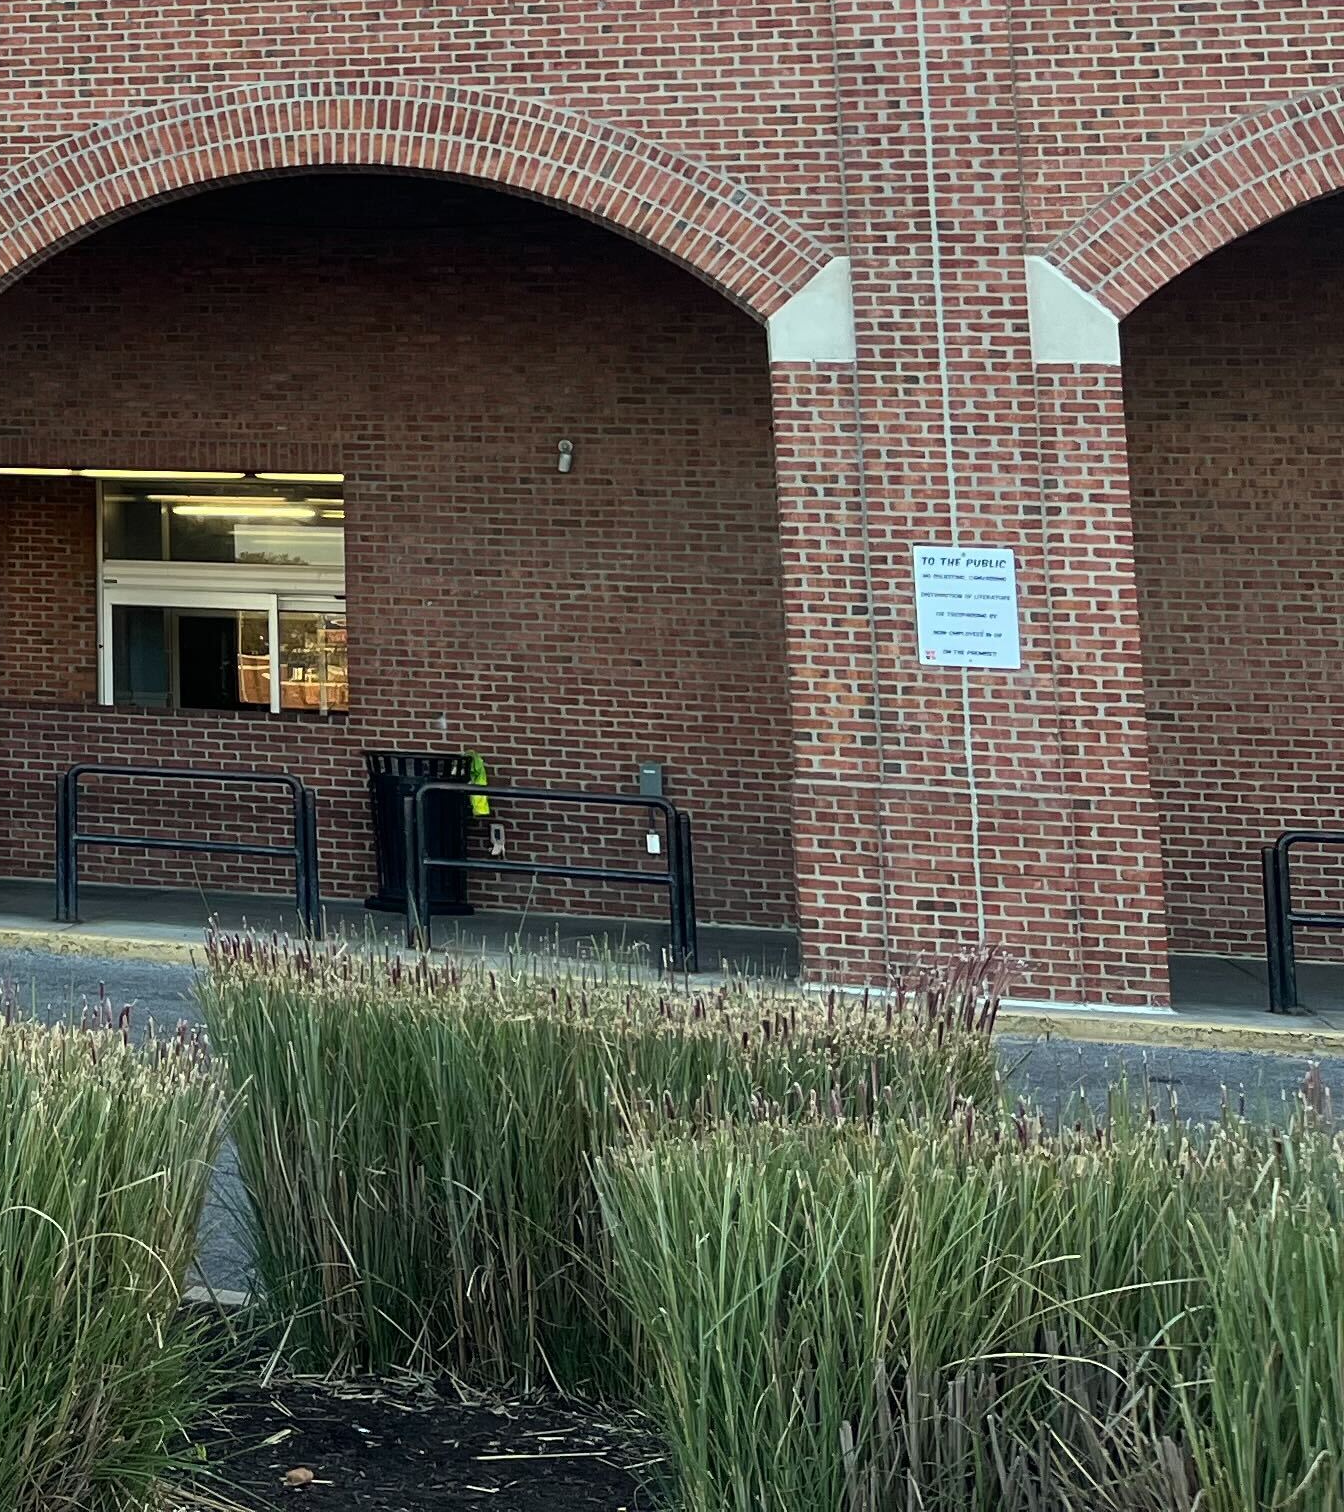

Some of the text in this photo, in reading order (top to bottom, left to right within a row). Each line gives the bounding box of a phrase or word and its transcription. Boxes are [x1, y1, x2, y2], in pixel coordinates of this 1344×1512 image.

[921, 556, 1007, 568] TO THE PUBLIC
